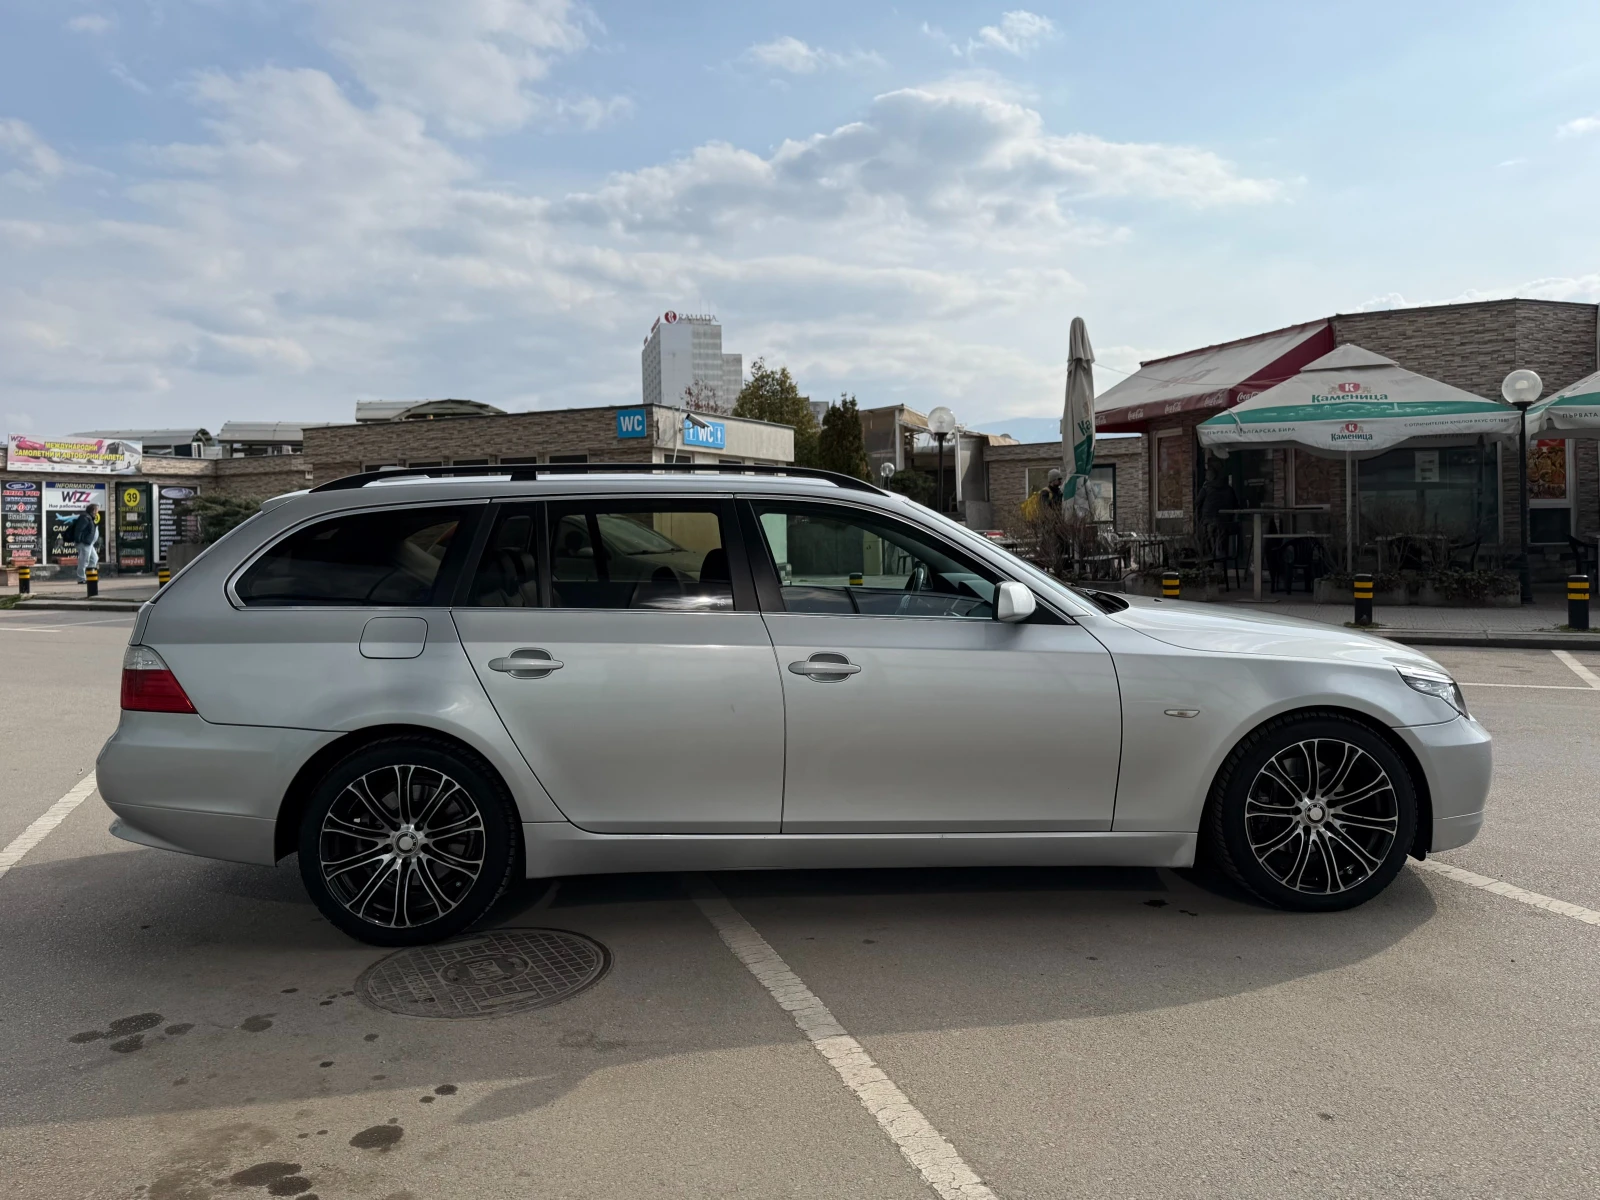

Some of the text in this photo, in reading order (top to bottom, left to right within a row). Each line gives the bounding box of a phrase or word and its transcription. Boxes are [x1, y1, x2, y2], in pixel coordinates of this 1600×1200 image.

[1311, 393, 1388, 403] Каменица
[620, 415, 643, 432] WC
[698, 425, 714, 443] WC
[1241, 427, 1277, 435] ЪЛГАРСКА
[1330, 433, 1373, 442] Каменица
[45, 441, 98, 451] МЕЖДУНАРОДНИ
[14, 449, 54, 458] САМОЛЕТНИ
[62, 452, 99, 461] АВТОБУСНИ
[126, 492, 138, 503] 39
